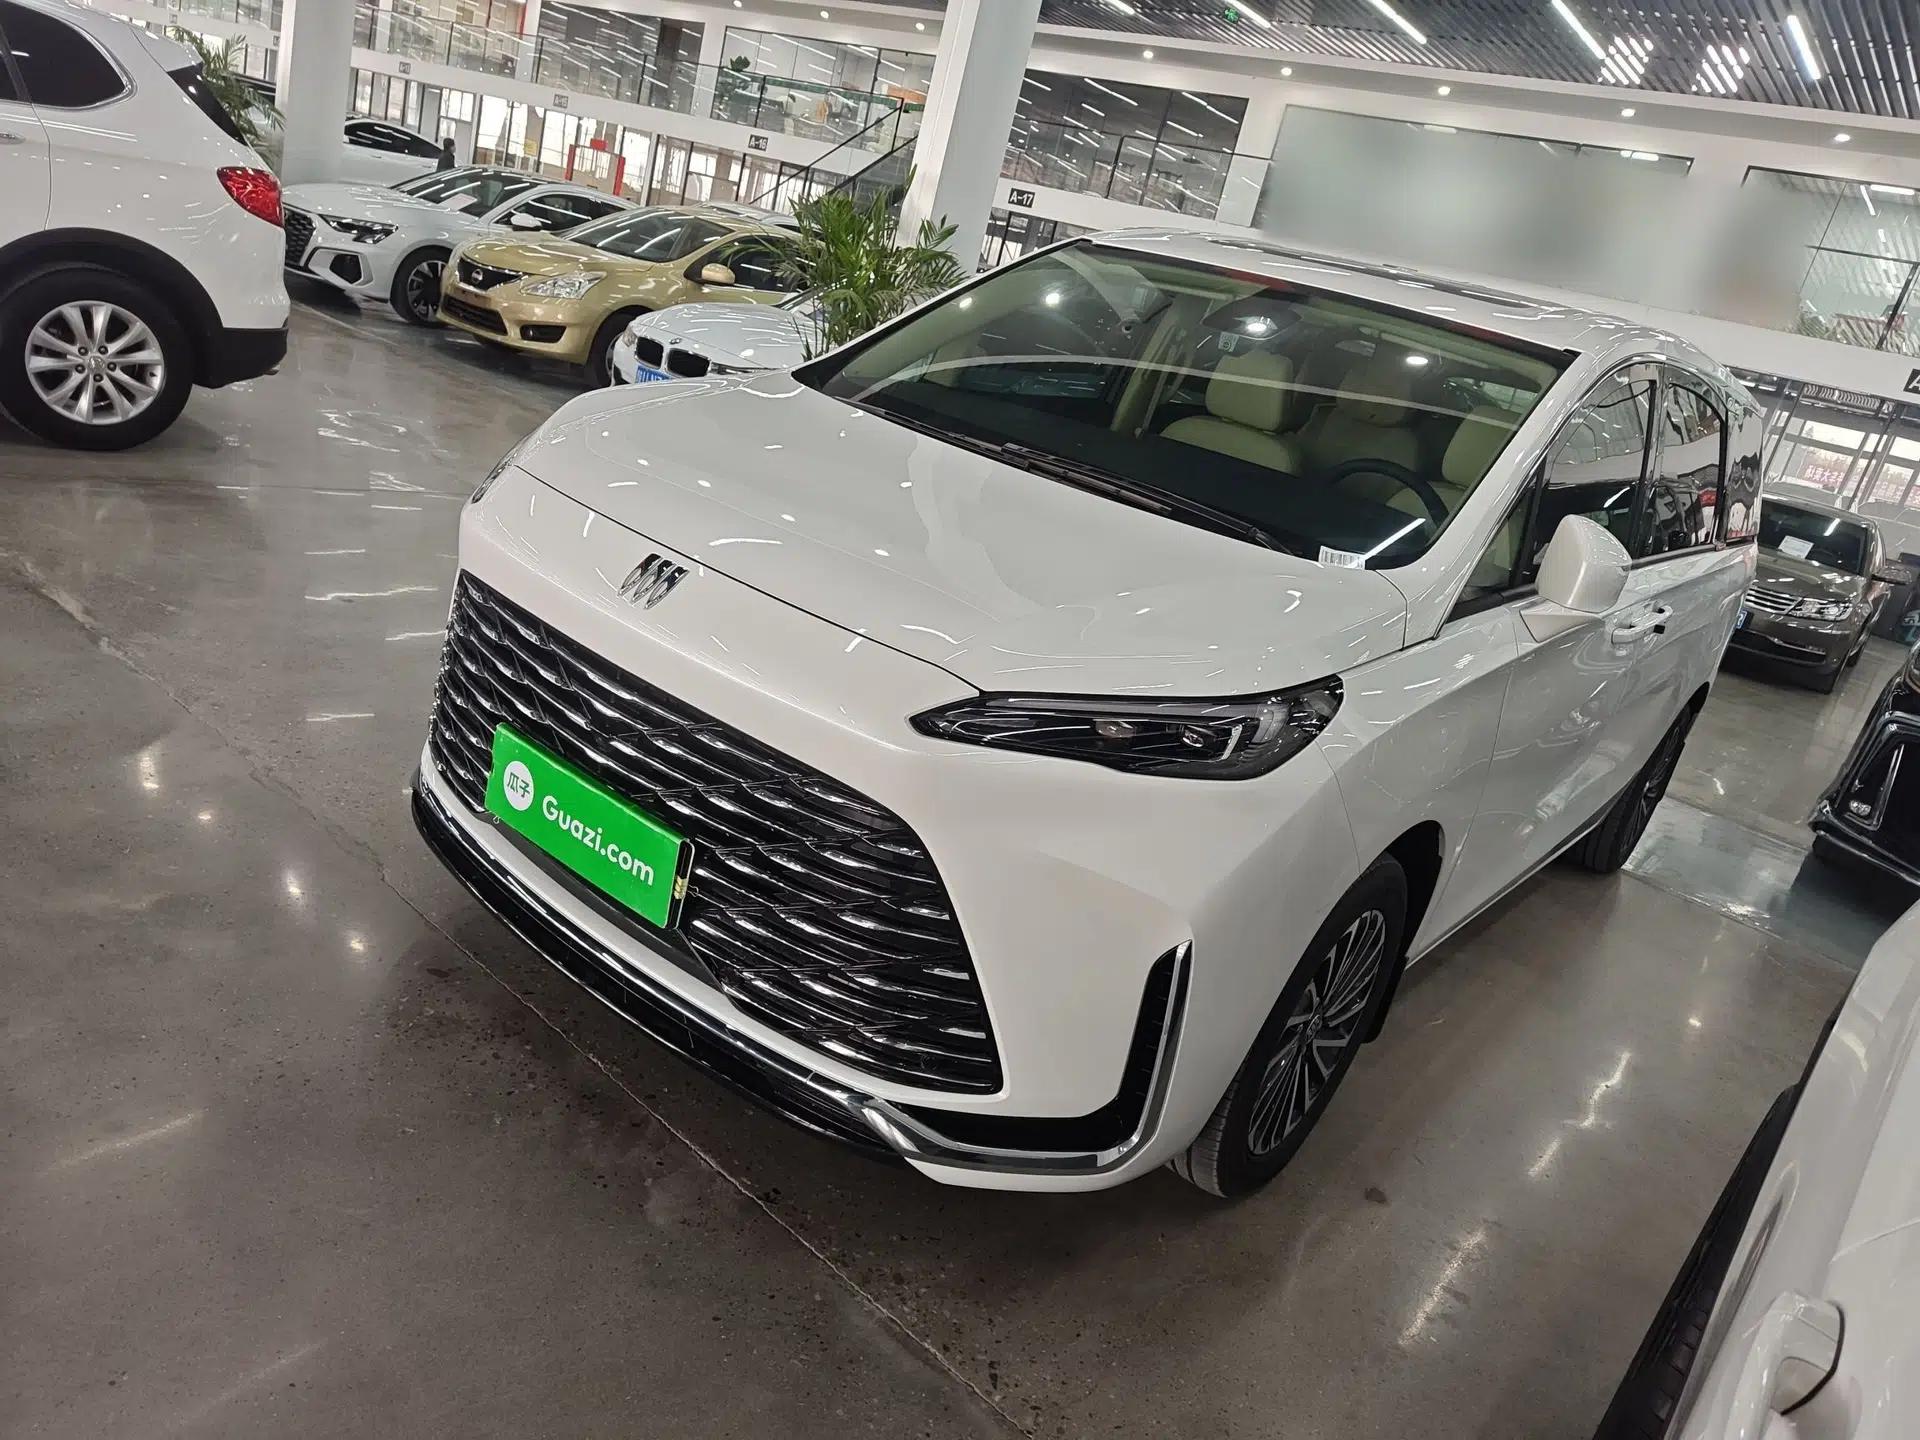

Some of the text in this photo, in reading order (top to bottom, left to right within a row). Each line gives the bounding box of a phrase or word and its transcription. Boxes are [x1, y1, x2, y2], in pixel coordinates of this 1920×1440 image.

[750, 136, 767, 149] A-16
[1010, 191, 1033, 206] A-17
[507, 772, 531, 797] 瓜子
[542, 795, 654, 886] Guazi.com
